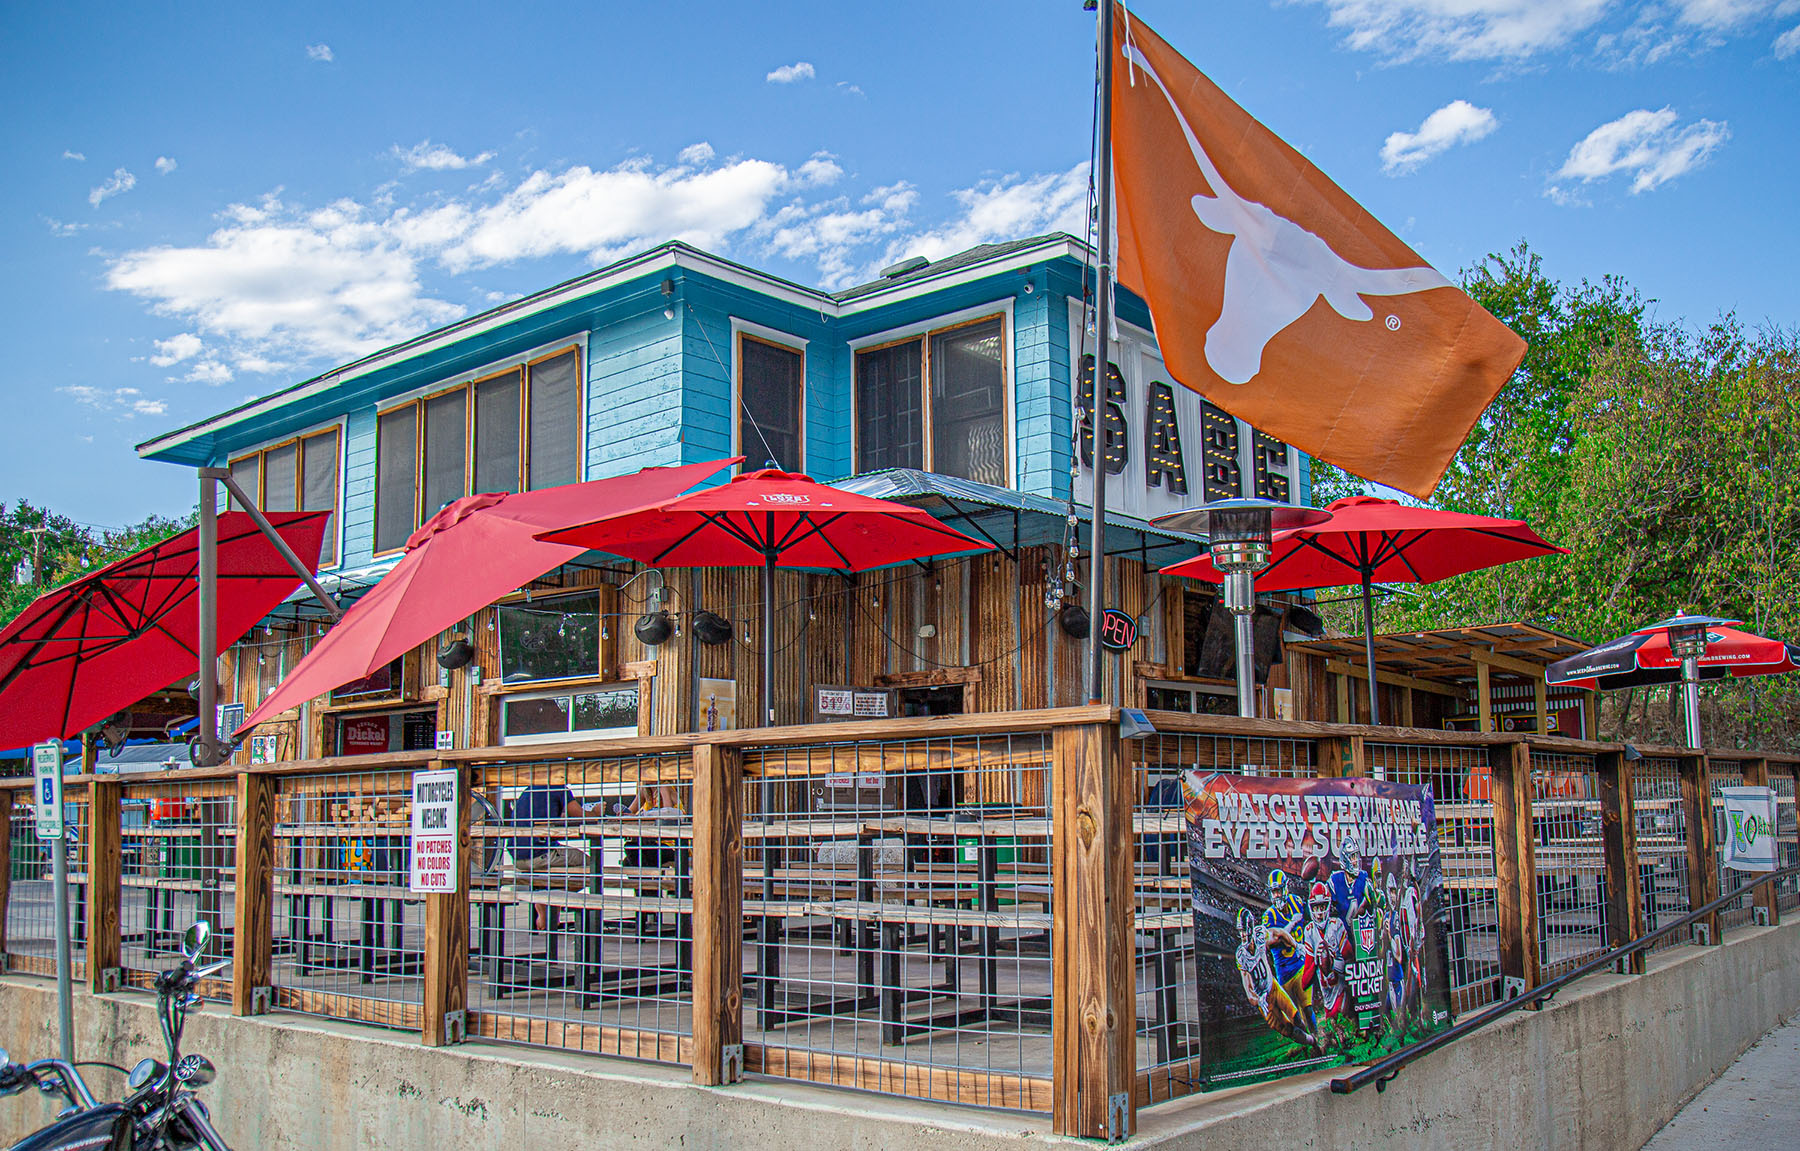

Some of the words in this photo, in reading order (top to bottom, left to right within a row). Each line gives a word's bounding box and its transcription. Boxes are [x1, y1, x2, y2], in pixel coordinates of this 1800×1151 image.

[821, 695, 851, 710] 51%
[348, 727, 385, 741] Dickel
[417, 782, 453, 803] MOTORCYCLES
[422, 808, 447, 829] WELCOME
[1215, 792, 1301, 824] WATCH
[1304, 795, 1371, 824] EVERY
[1370, 797, 1392, 824] LIVE
[416, 841, 425, 854] NO
[426, 840, 452, 854] PATCHES
[1202, 819, 1307, 859] EVERY
[1312, 821, 1394, 859] SUNDAY
[418, 857, 426, 870] NO
[427, 856, 450, 870] COLORS
[421, 873, 429, 886] NO
[431, 873, 447, 886] CUTS
[1344, 960, 1384, 981] SUNDAY
[1348, 976, 1384, 997] TICKET
